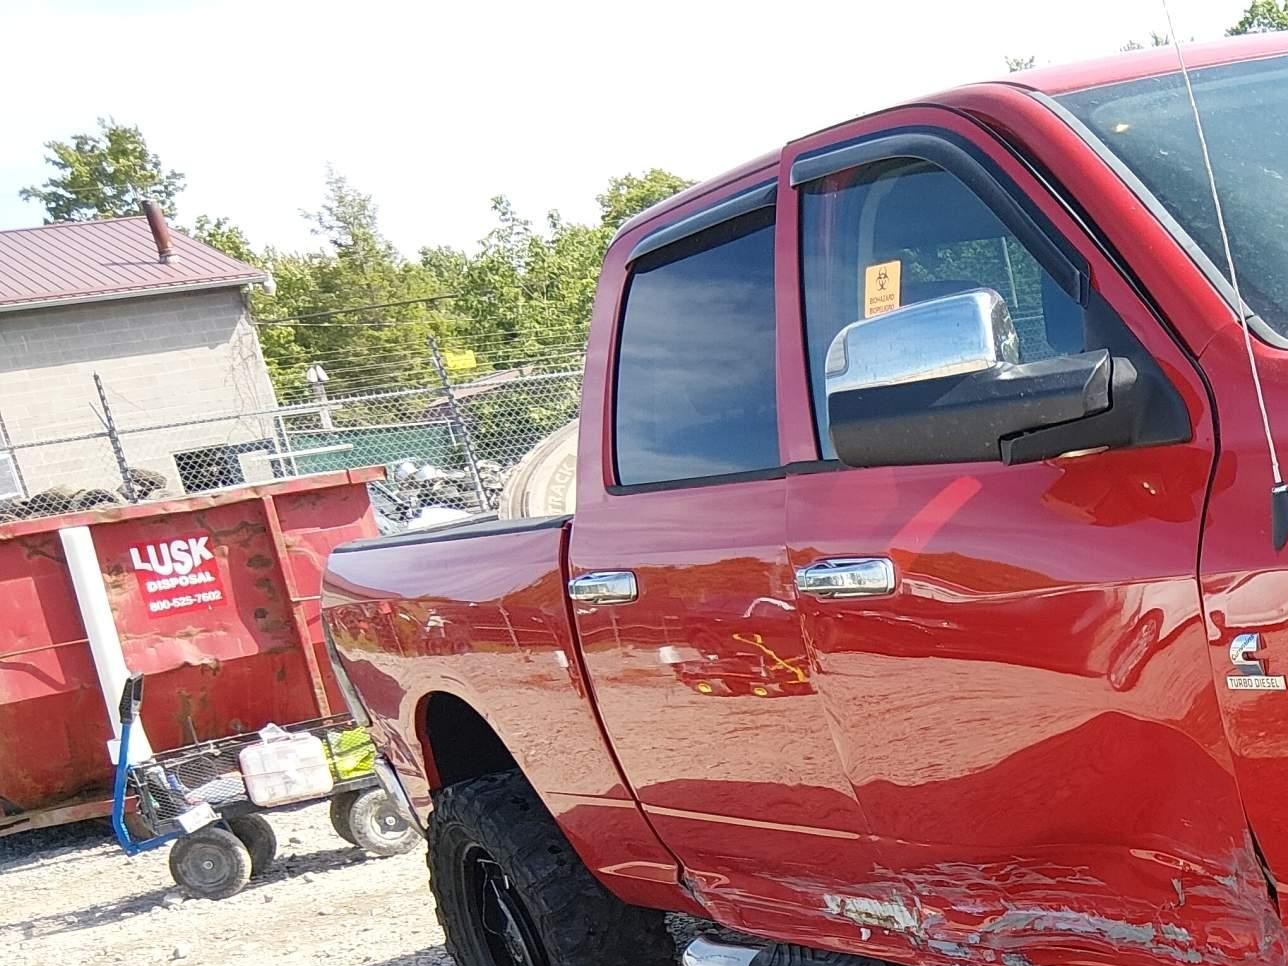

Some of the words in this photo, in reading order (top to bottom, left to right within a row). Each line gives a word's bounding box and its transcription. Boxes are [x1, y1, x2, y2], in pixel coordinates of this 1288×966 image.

[549, 461, 576, 514] TRACK
[129, 536, 215, 575] LUSK
[145, 571, 216, 593] DISPOSAL
[1229, 678, 1253, 688] TURBO
[1254, 678, 1280, 689] DIESEL
